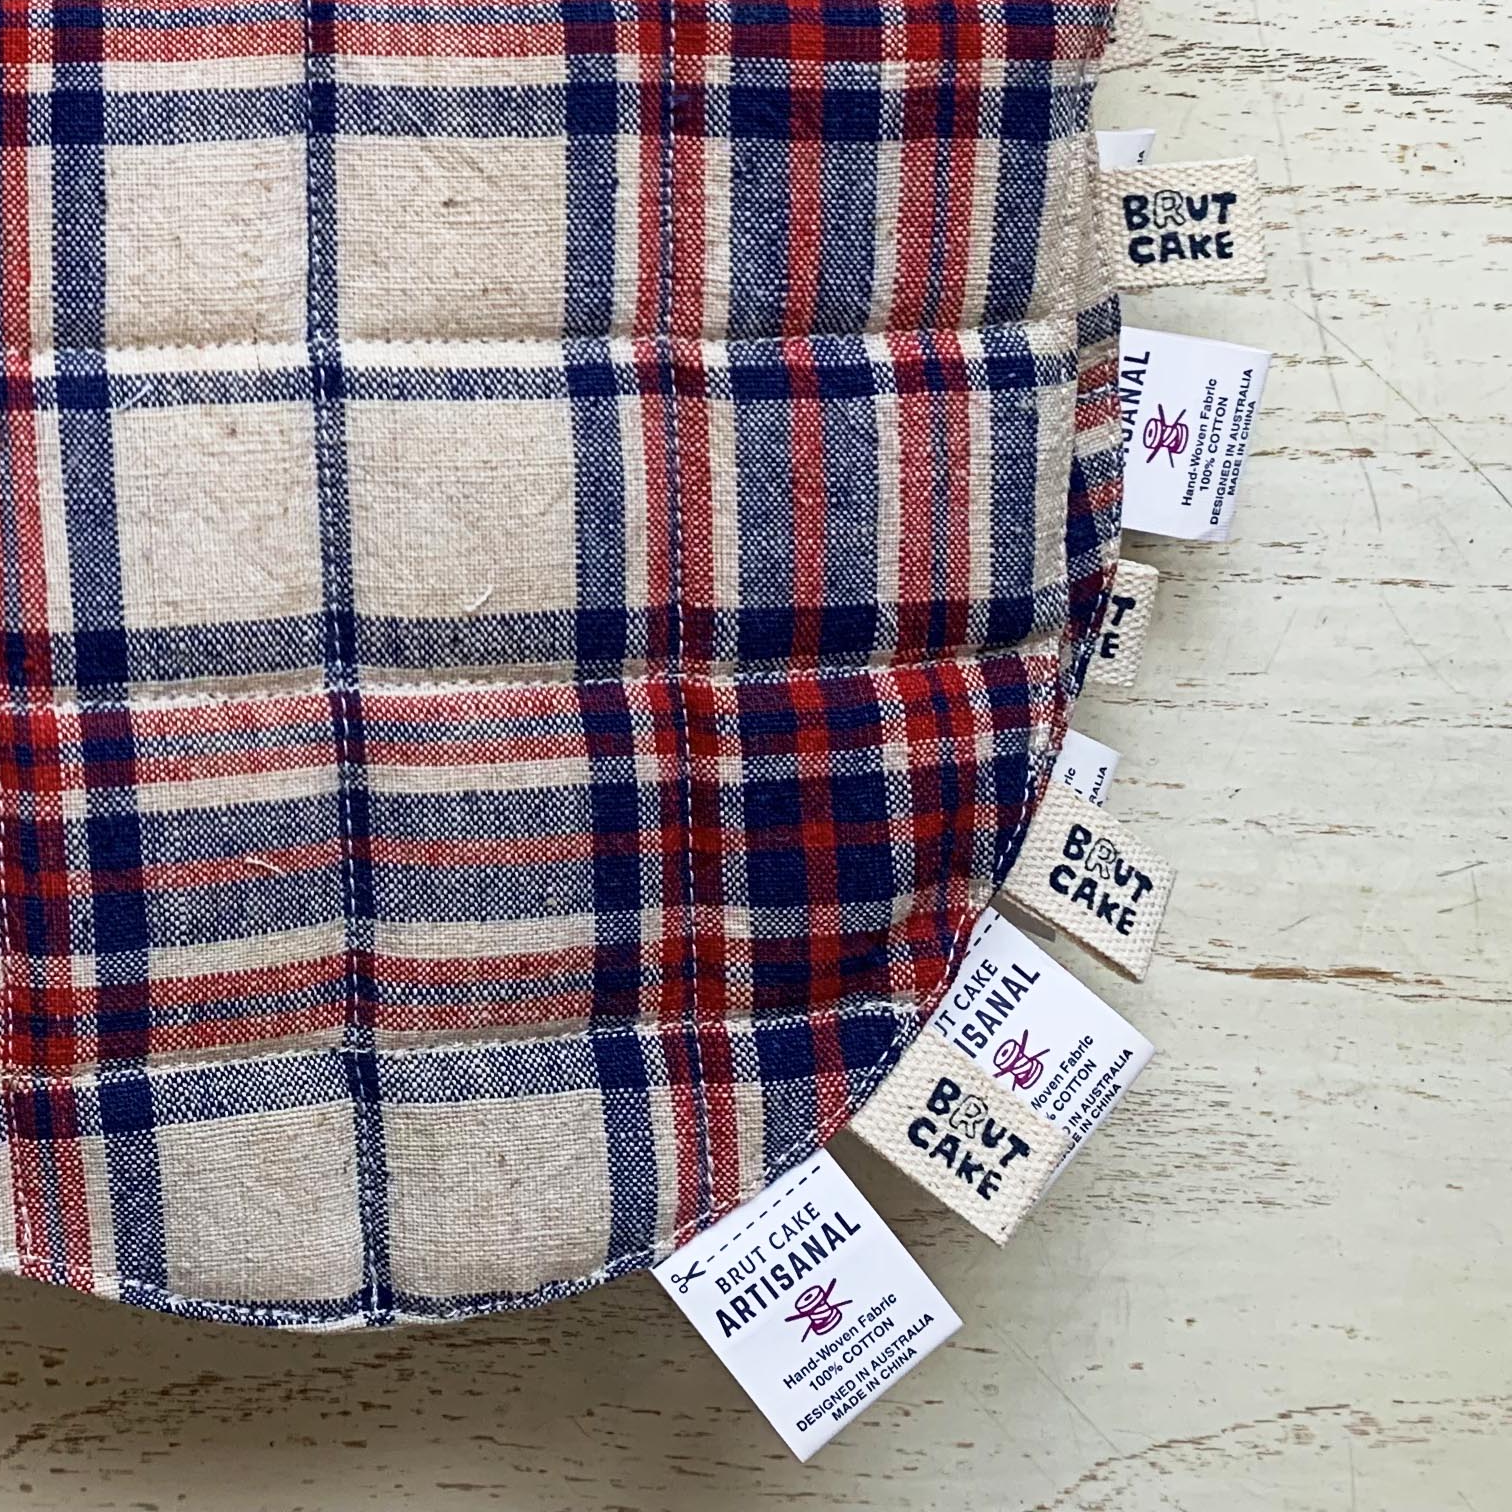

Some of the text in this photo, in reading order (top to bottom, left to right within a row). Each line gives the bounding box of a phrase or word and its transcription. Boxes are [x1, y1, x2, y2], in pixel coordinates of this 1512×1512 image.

[1122, 189, 1238, 231] BRUT
[1128, 231, 1235, 265] CAKE
[1181, 378, 1218, 506] Hand-Woven Fabric
[1199, 396, 1229, 491] 100% COTTON
[1209, 369, 1253, 525] DESIGNED IN AUSTRALIA
[1227, 400, 1256, 496] MADE IN CHINA
[1049, 864, 1137, 936] CAKE
[1062, 823, 1153, 903] BRUT
[954, 958, 998, 1010] CAKE
[1052, 1058, 1097, 1111] COTTON
[1059, 1035, 1094, 1074] Fabric
[1068, 1049, 1133, 1127] IN AUSTRALIA
[927, 1077, 1031, 1168] BRUT
[1079, 1119, 1093, 1133] IN
[1091, 1083, 1122, 1119] CHINA
[908, 1117, 1002, 1200] CAKE
[715, 1201, 821, 1295] BRUT CAKE
[716, 1211, 862, 1338] ARTISANAL
[783, 1293, 897, 1389] Hand-Woven Fabric
[796, 1313, 935, 1432] DESIGNED IN AUSTRALIA
[809, 1317, 895, 1391] 100% COTTON
[831, 1347, 918, 1421] MADE IN CHINA
